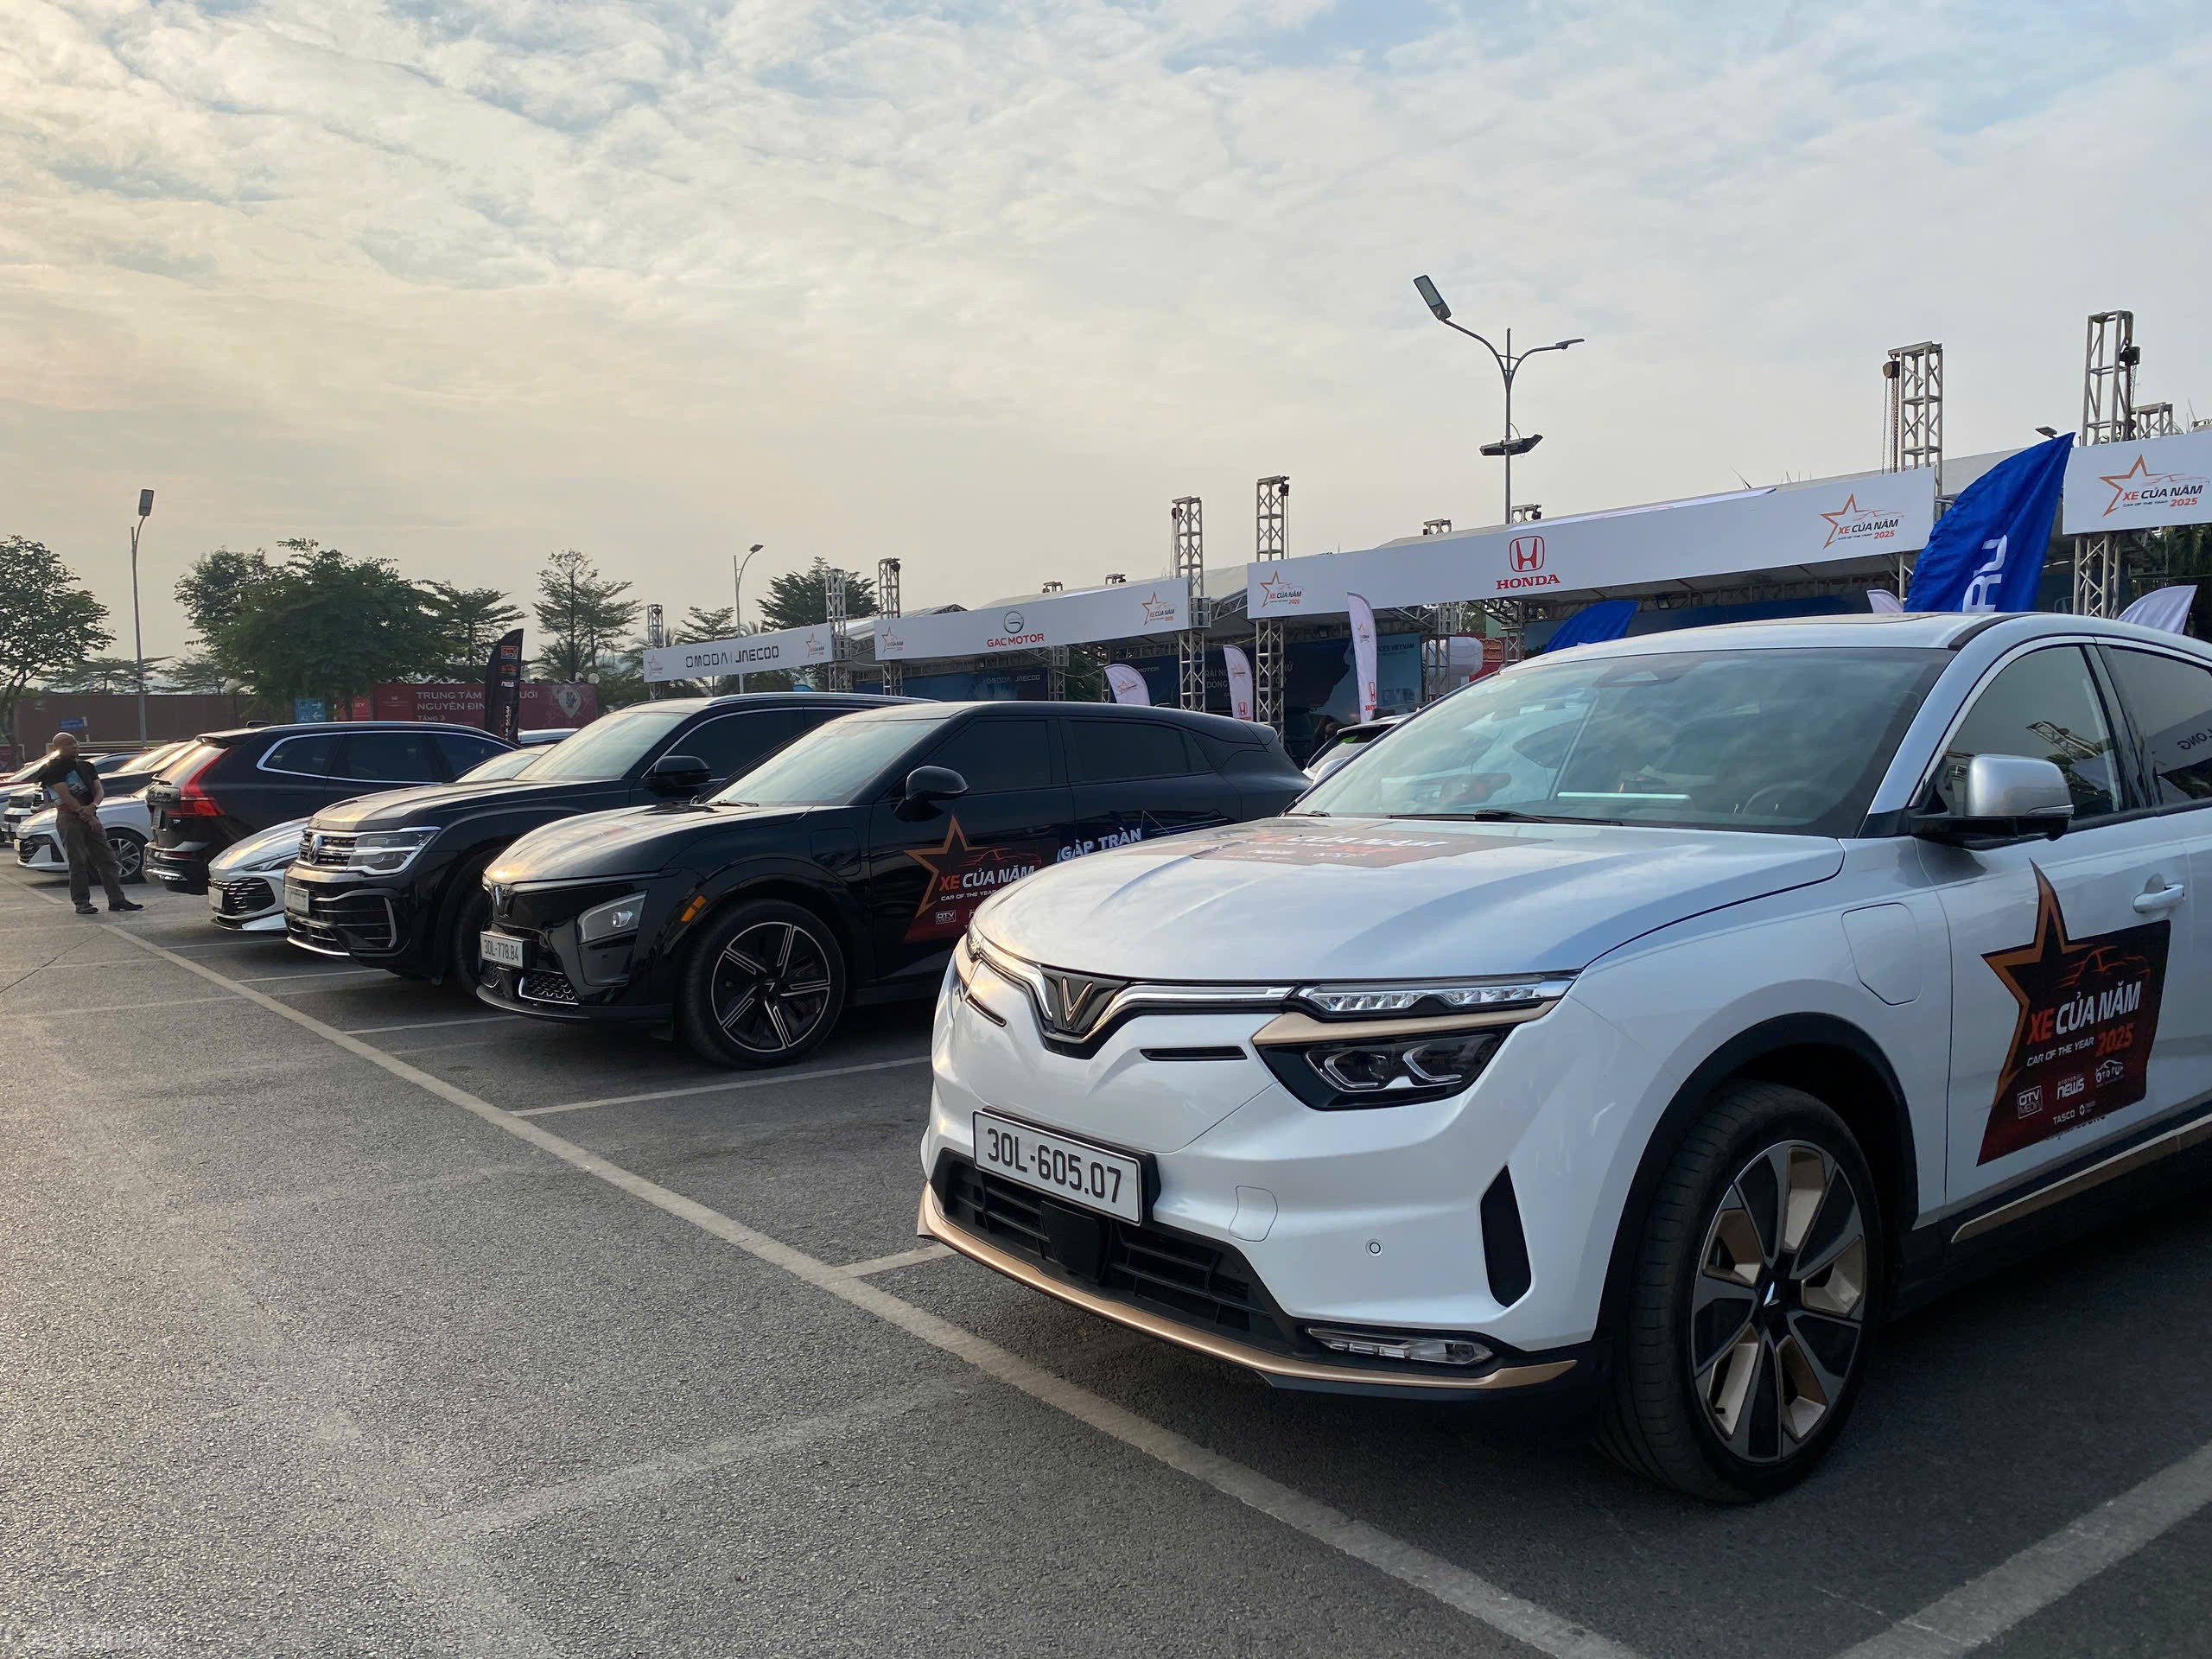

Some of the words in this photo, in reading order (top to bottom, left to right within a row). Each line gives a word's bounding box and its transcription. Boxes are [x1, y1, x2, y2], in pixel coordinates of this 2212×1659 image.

[2122, 491, 2139, 501] XE
[2170, 484, 2203, 497] NĂM
[2170, 497, 2198, 507] 2025
[1838, 525, 1851, 535] XE
[1873, 518, 1899, 531] NĂM
[1873, 530, 1895, 539] 2025
[1496, 574, 1561, 590] HONDA
[987, 638, 1007, 647] GAC
[1007, 632, 1045, 645] MOTOR
[685, 652, 728, 668] OMODA
[735, 645, 779, 664] JAECOO
[458, 690, 482, 699] TÂM
[1098, 827, 1141, 849] TRÀN
[939, 874, 961, 892] XE
[962, 868, 995, 888] CỦA
[997, 864, 1035, 883] NĂM
[2026, 1007, 2056, 1046] XE
[2056, 991, 2094, 1035] CỦA
[2097, 981, 2142, 1022] NĂM
[2094, 1022, 2134, 1058] 2025
[2026, 1054, 2044, 1067] CAR
[2045, 1049, 2057, 1061] OF
[2057, 1043, 2073, 1056] THE
[2074, 1036, 2094, 1051] YEAR
[2052, 1109, 2075, 1125] TASCO
[987, 1127, 1122, 1204] 30L-605.07
